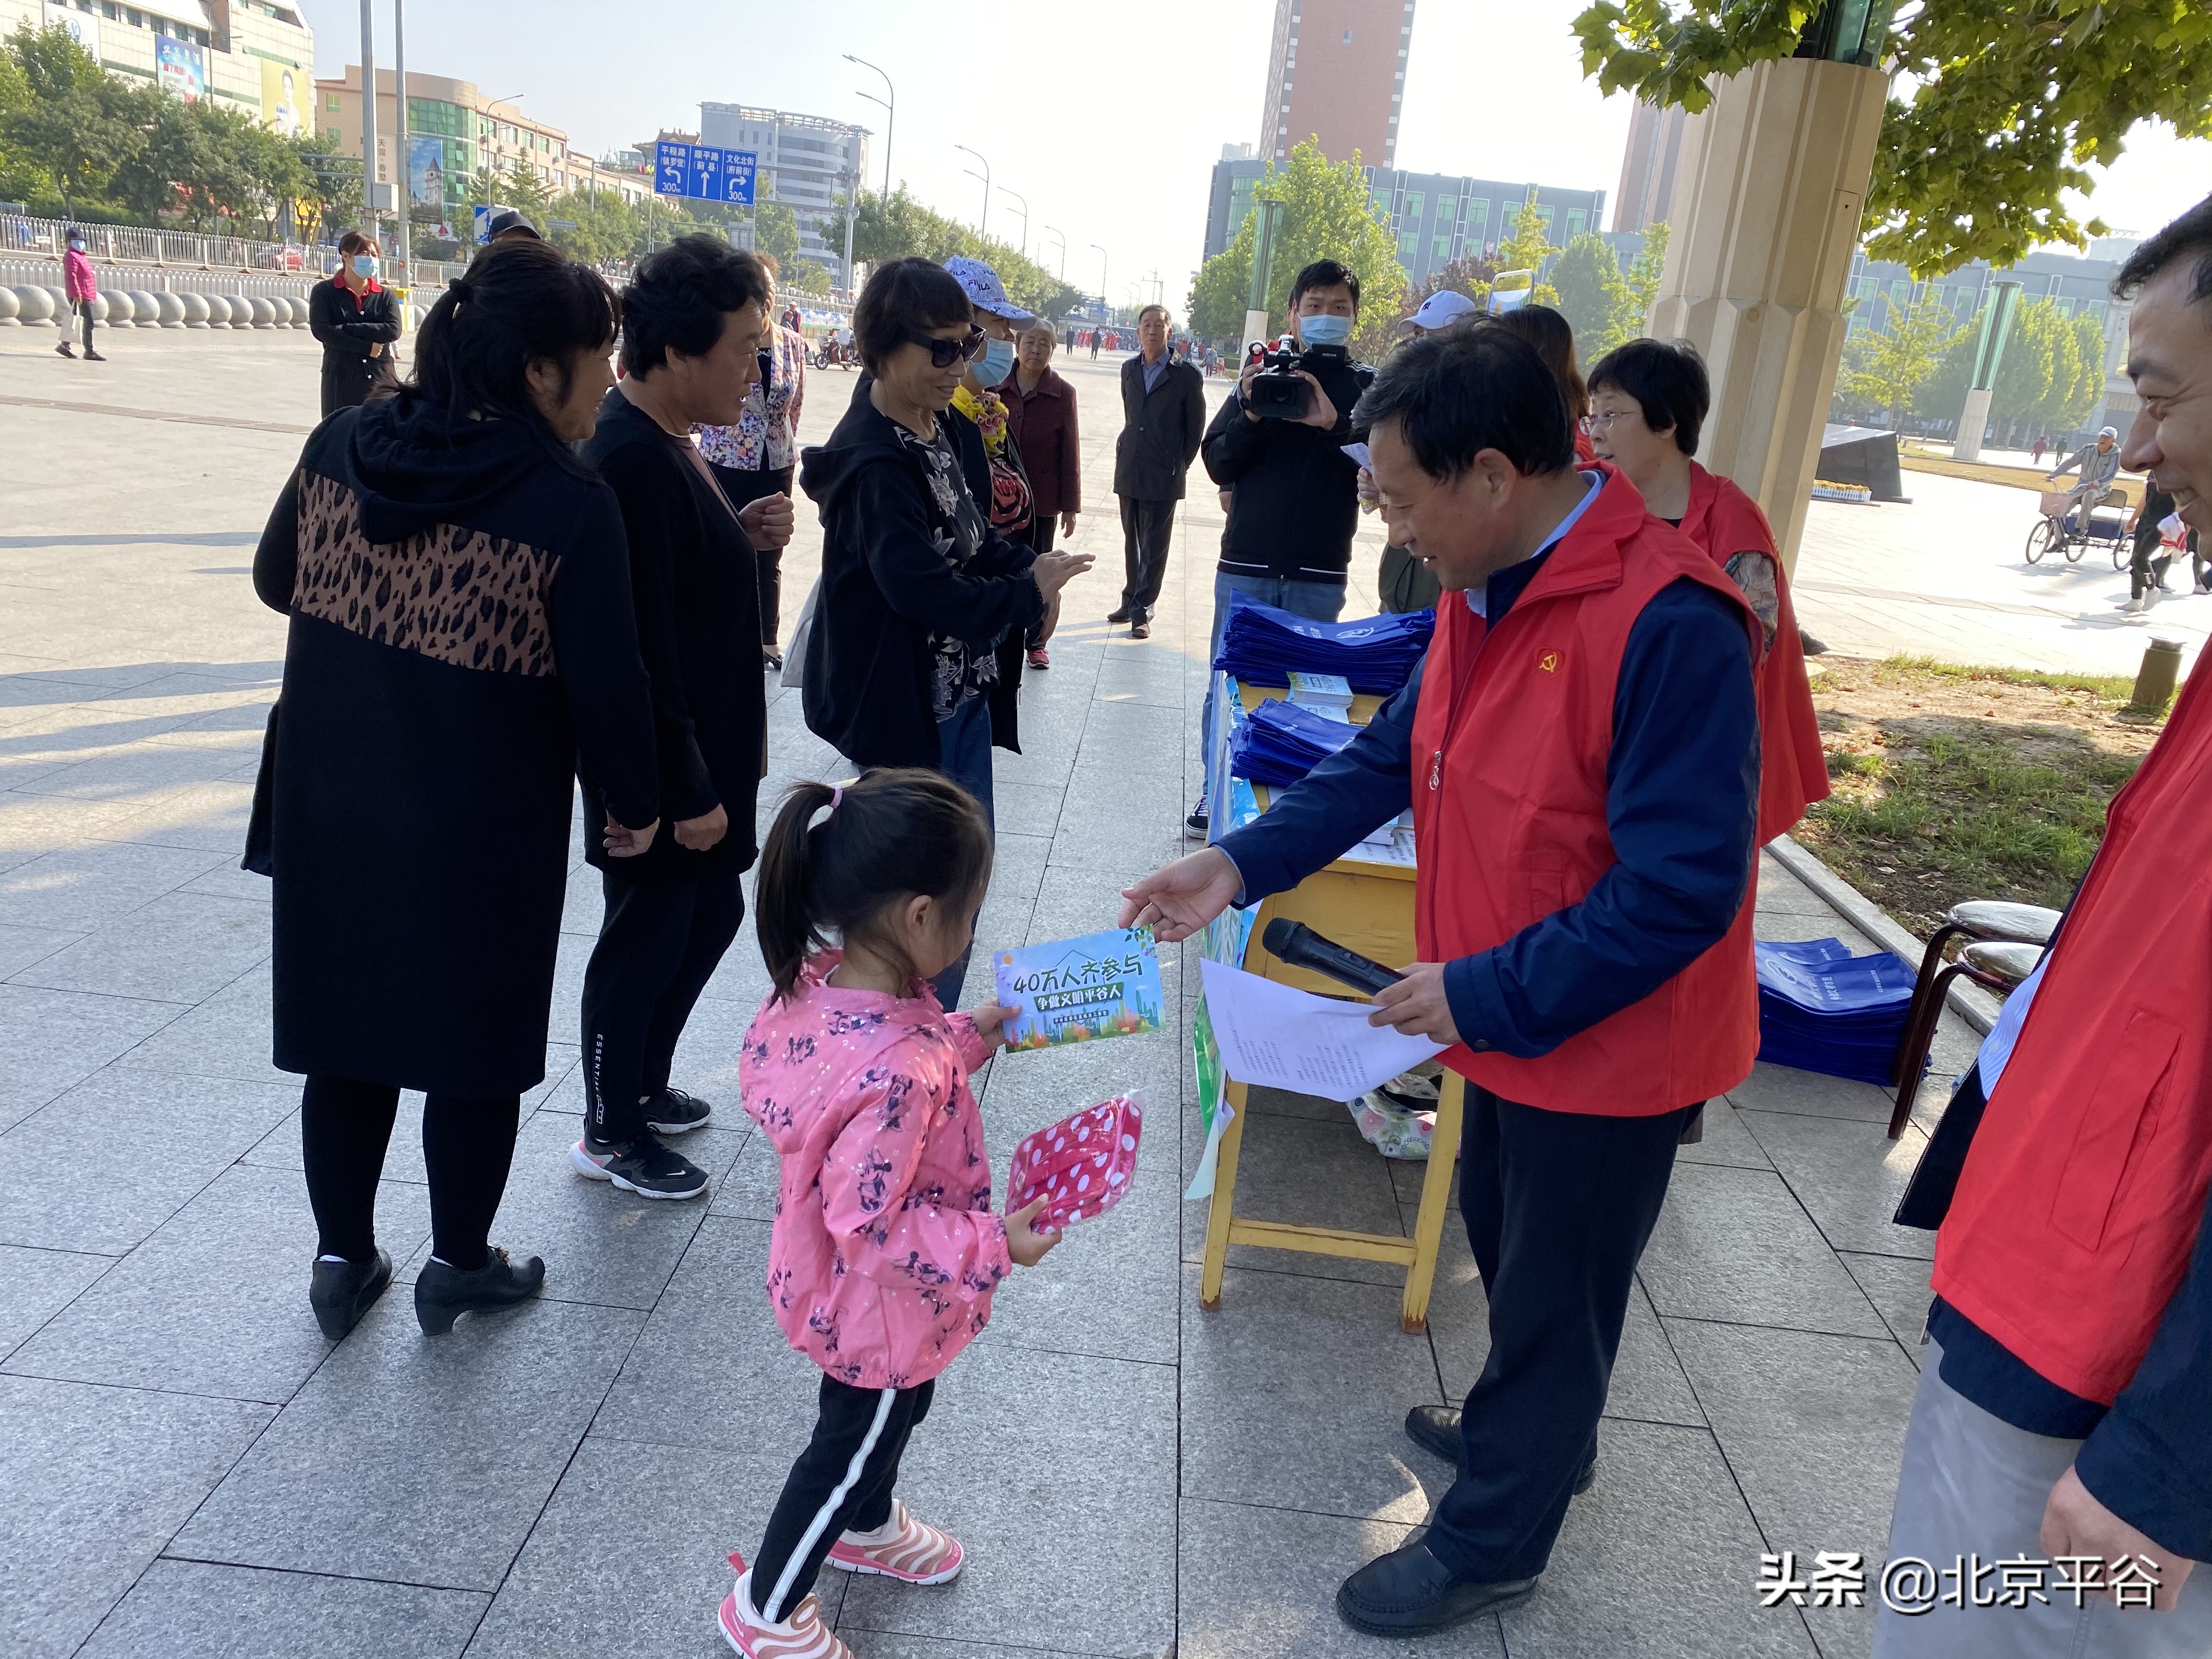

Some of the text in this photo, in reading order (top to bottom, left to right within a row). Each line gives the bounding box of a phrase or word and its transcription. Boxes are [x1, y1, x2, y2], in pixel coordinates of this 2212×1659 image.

[661, 145, 686, 157] 平程路
[694, 150, 719, 161] 顺平路
[726, 154, 754, 166] 文化北街
[662, 182, 681, 194] 300m
[728, 191, 747, 202] 300m
[1013, 953, 1143, 995] 40万人齐参与
[1037, 984, 1122, 1011] 争做文明平谷人
